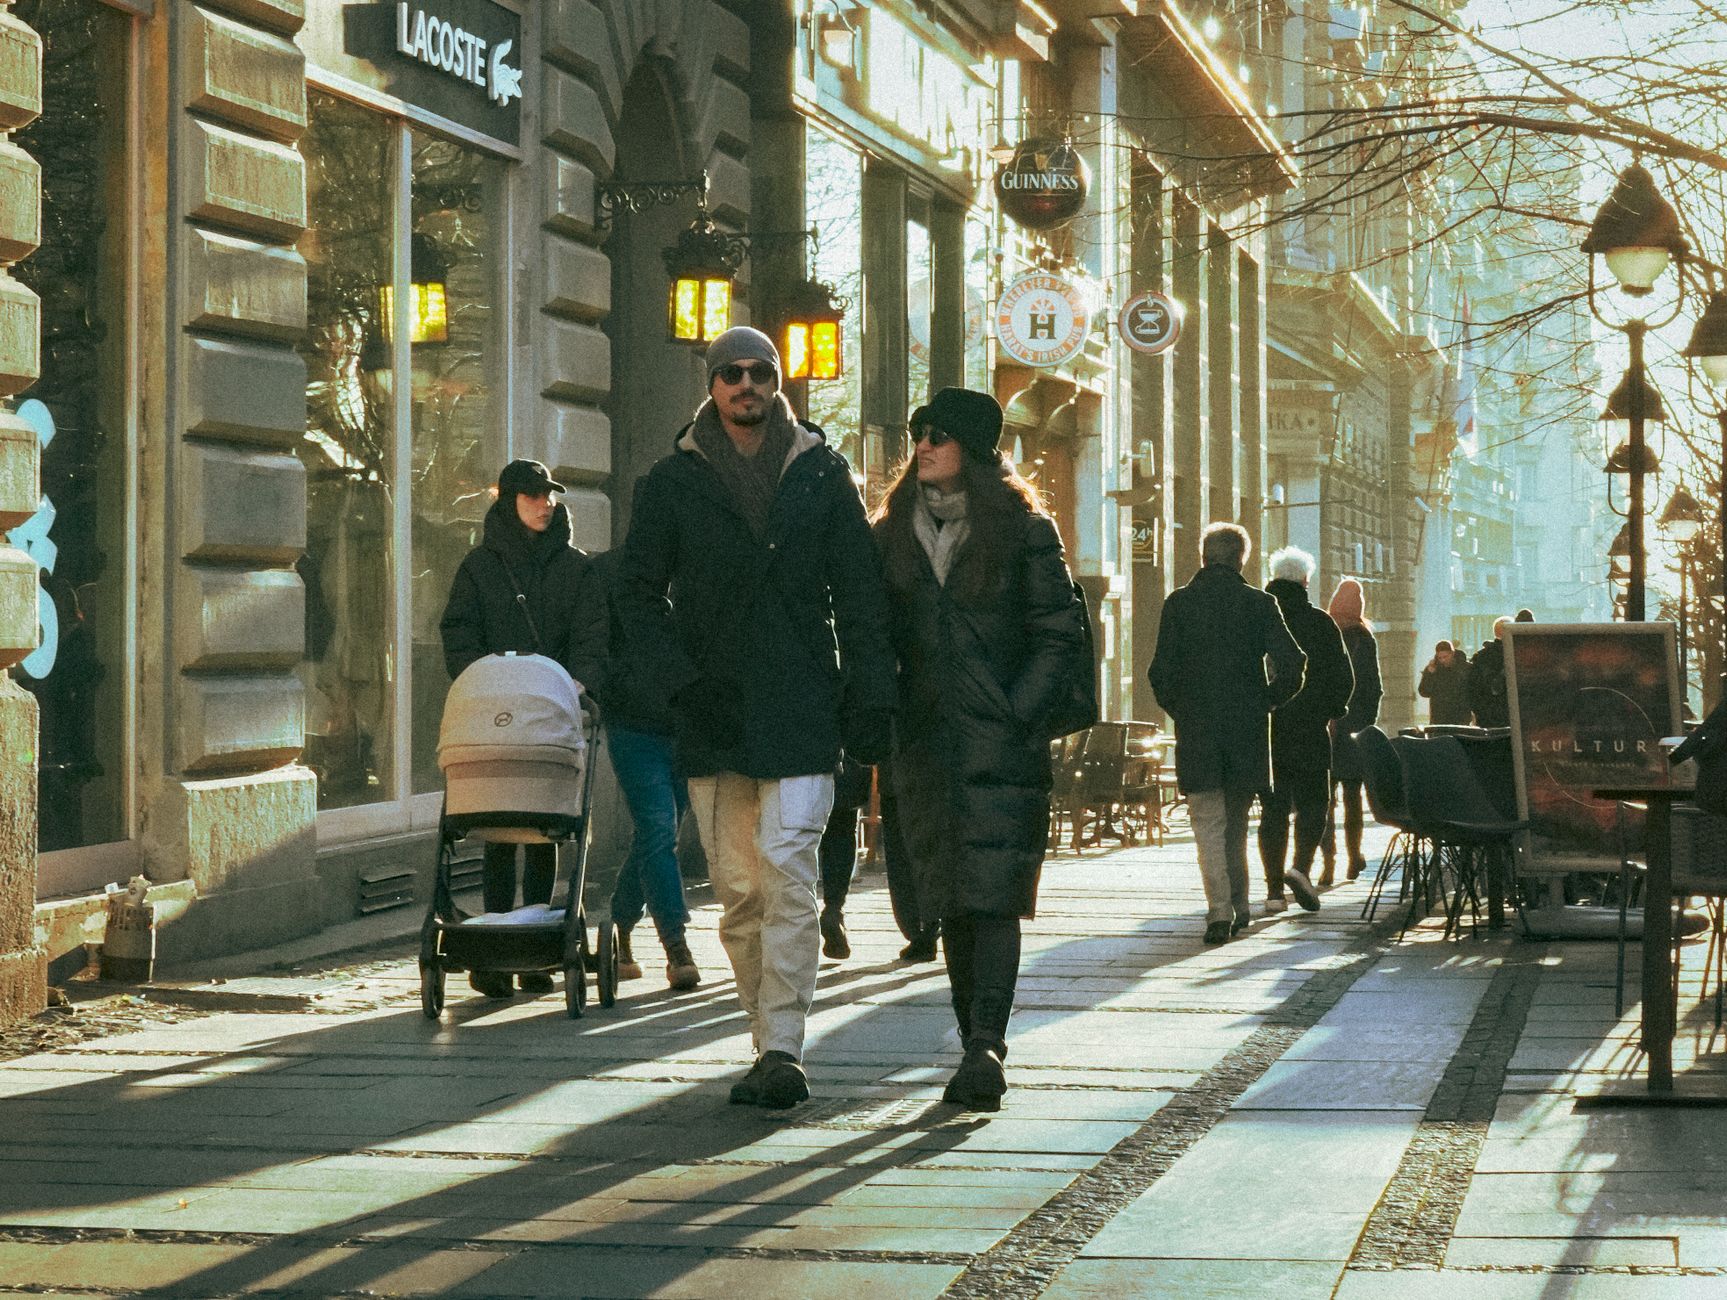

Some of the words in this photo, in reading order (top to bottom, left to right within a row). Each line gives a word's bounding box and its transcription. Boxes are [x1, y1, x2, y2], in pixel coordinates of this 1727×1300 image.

[397, 2, 486, 87] LACOSTE
[1001, 171, 1078, 190] GUINNESS
[1029, 314, 1056, 339] H
[1038, 346, 1068, 361] IRISH
[1067, 326, 1084, 347] PUB
[1531, 740, 1649, 753] KULTUR
